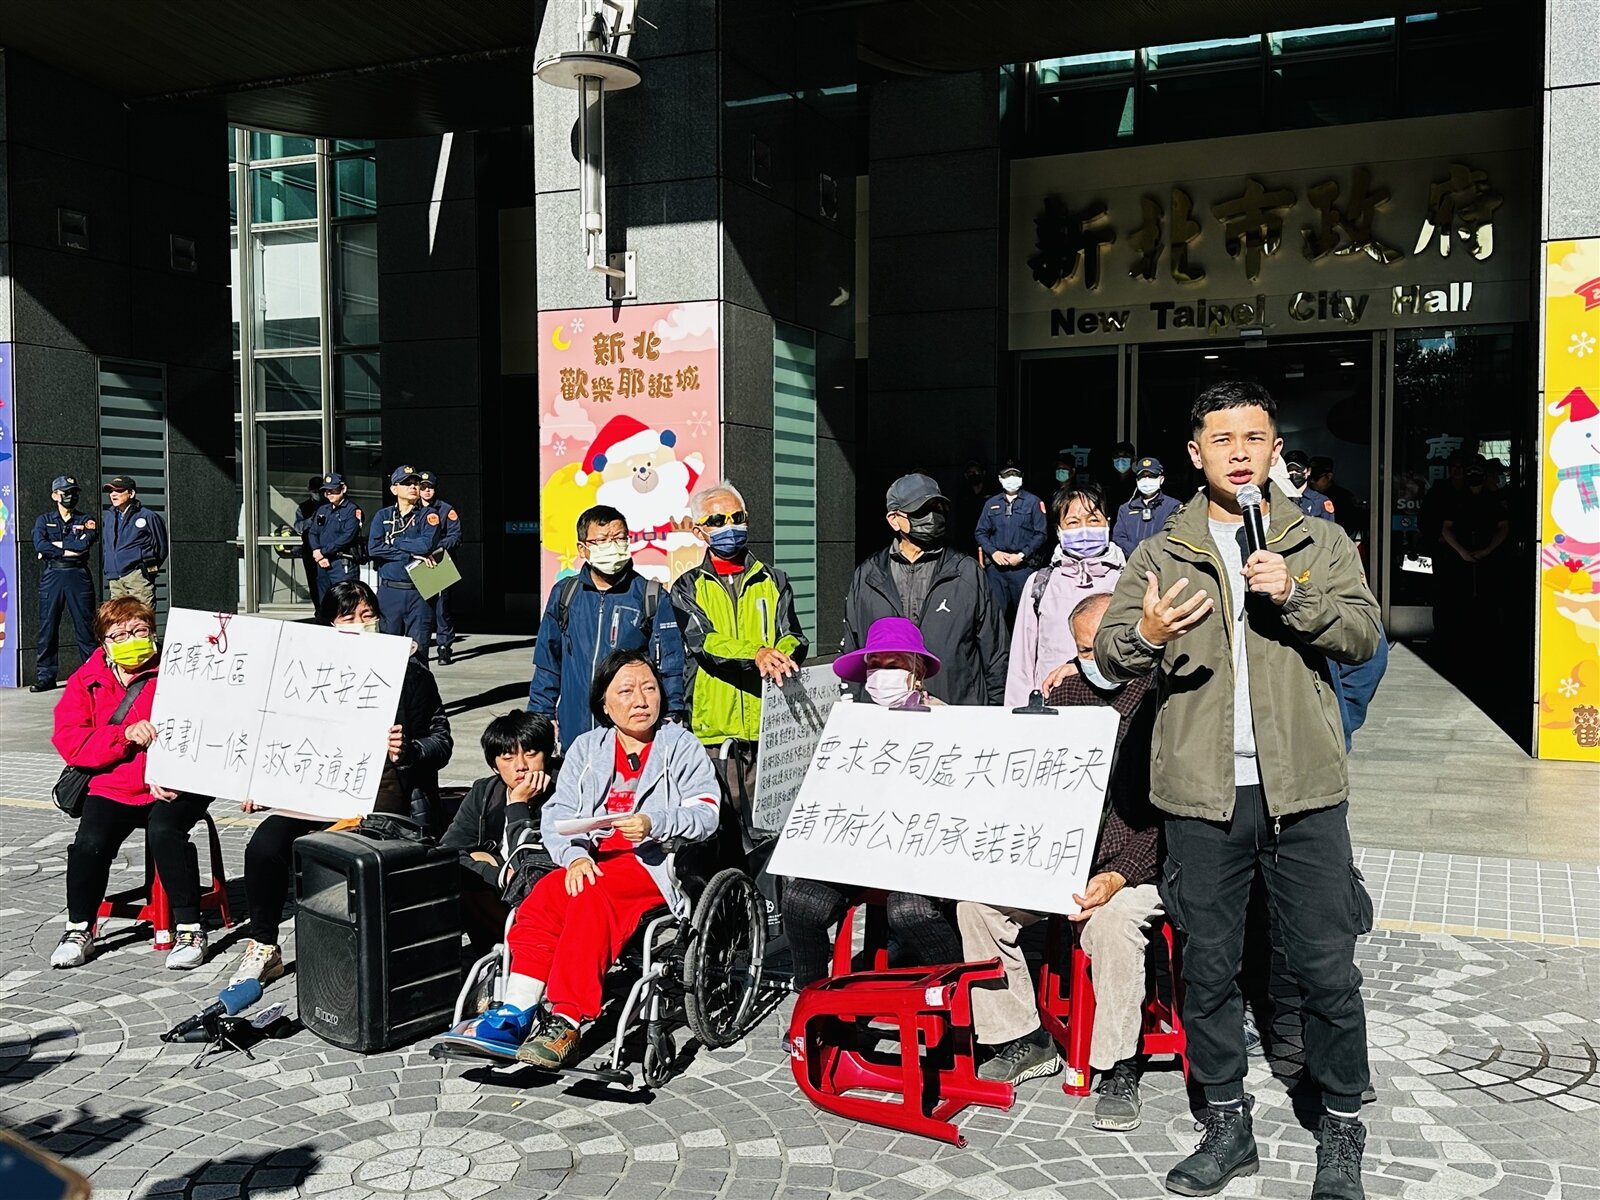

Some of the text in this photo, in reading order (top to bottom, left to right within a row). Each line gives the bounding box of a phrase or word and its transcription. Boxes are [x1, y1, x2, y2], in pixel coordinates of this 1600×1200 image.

[1027, 162, 1504, 291] 新北市政府
[1050, 281, 1474, 337] New Taipei City Hall
[592, 330, 662, 366] 新北
[559, 365, 701, 403] 歡樂耶誕城
[163, 641, 391, 709] 保障社區 公共安全
[156, 718, 373, 800] 規劃一條 救命通道
[816, 735, 1107, 792] 要求各局處共同解決
